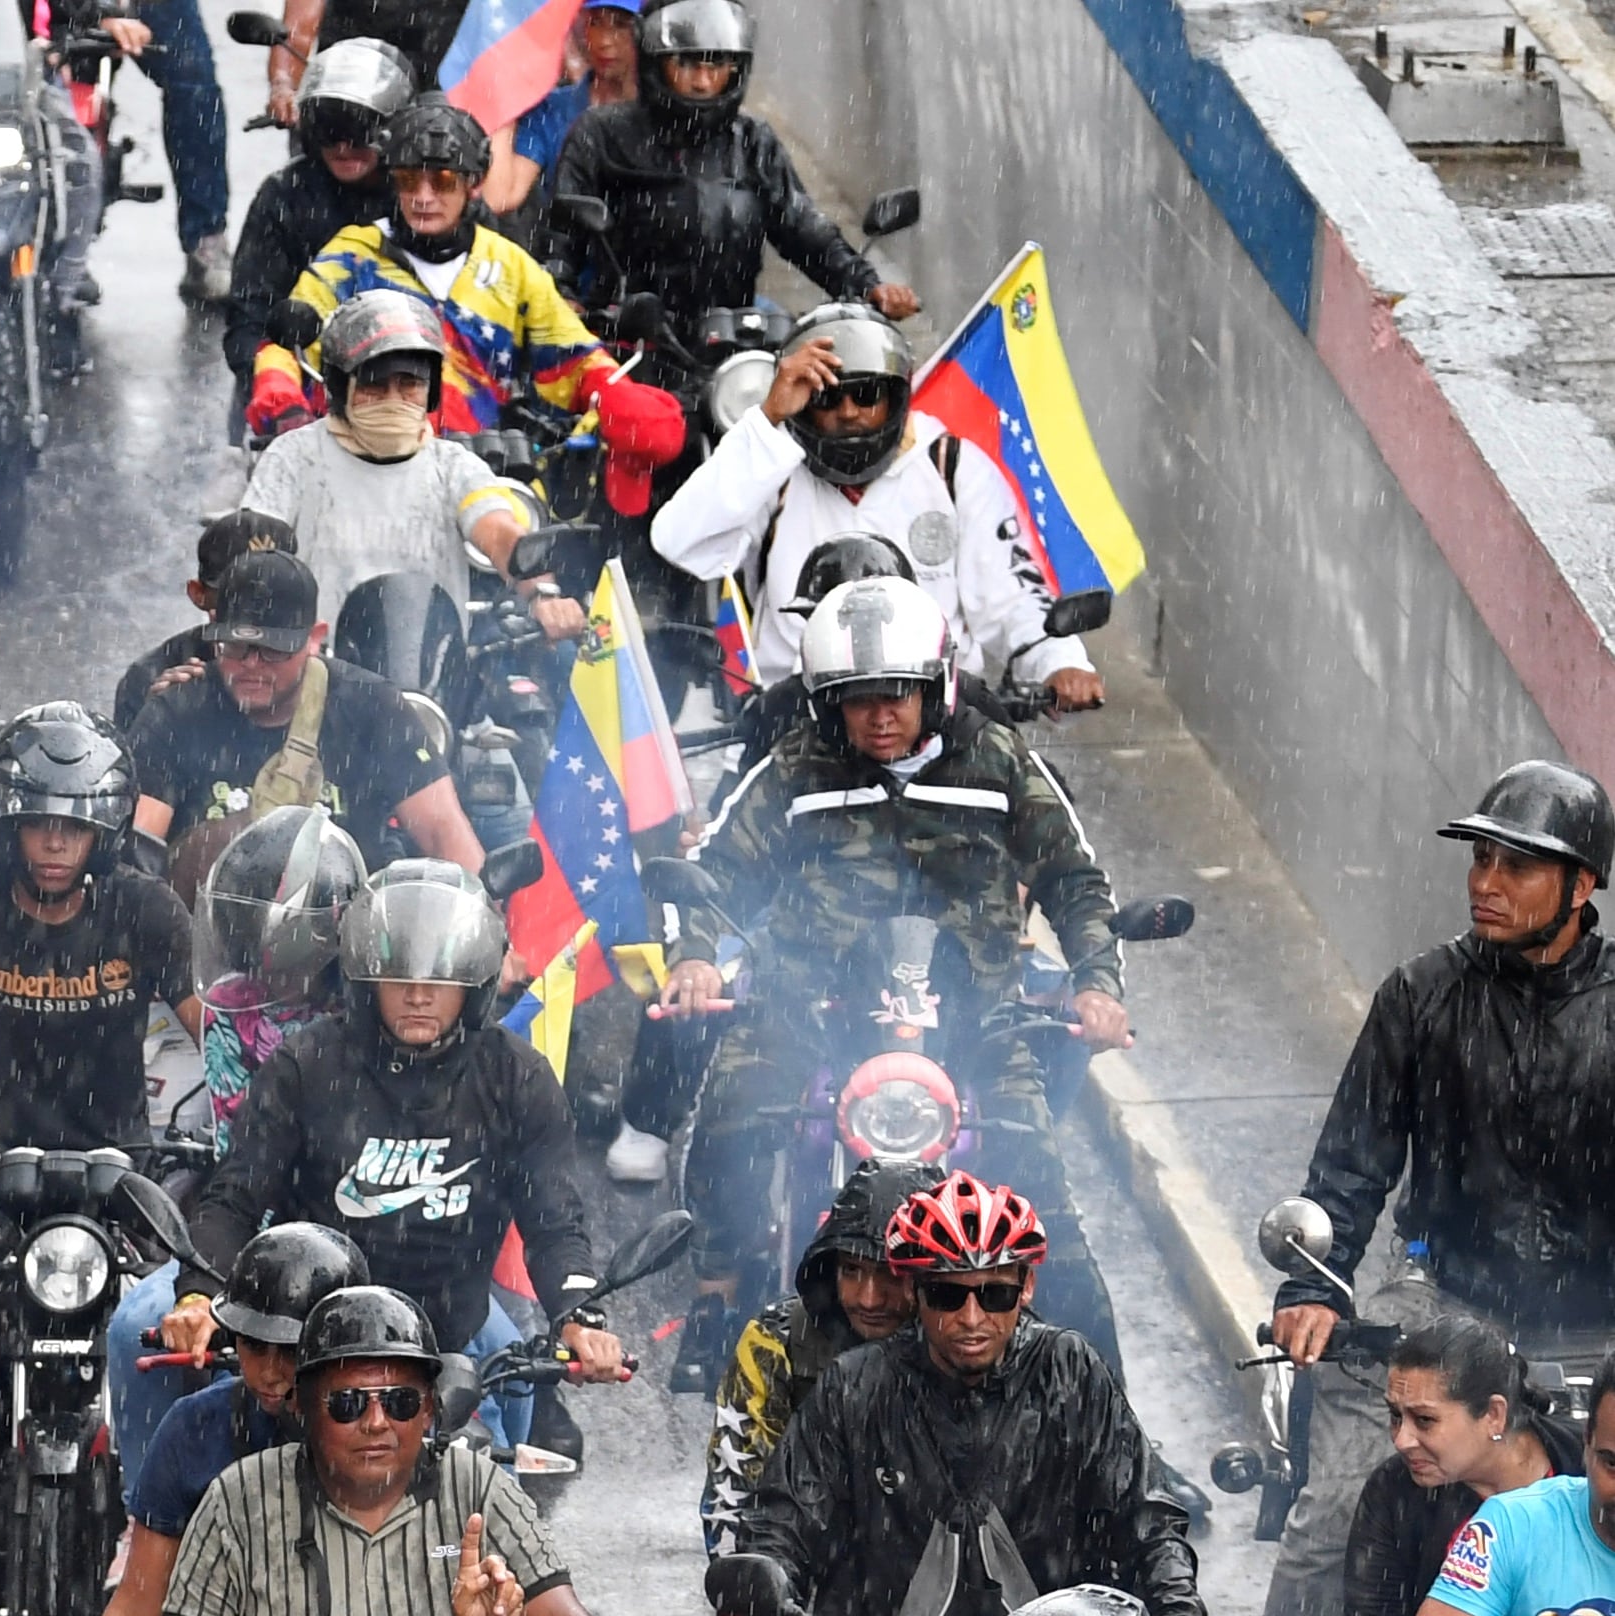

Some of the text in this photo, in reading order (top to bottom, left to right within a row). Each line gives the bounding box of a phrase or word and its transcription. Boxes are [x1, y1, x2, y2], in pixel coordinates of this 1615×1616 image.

[356, 1137, 452, 1186] NIKE
[421, 1183, 472, 1221] SB
[32, 1339, 94, 1354] KEEWAY
